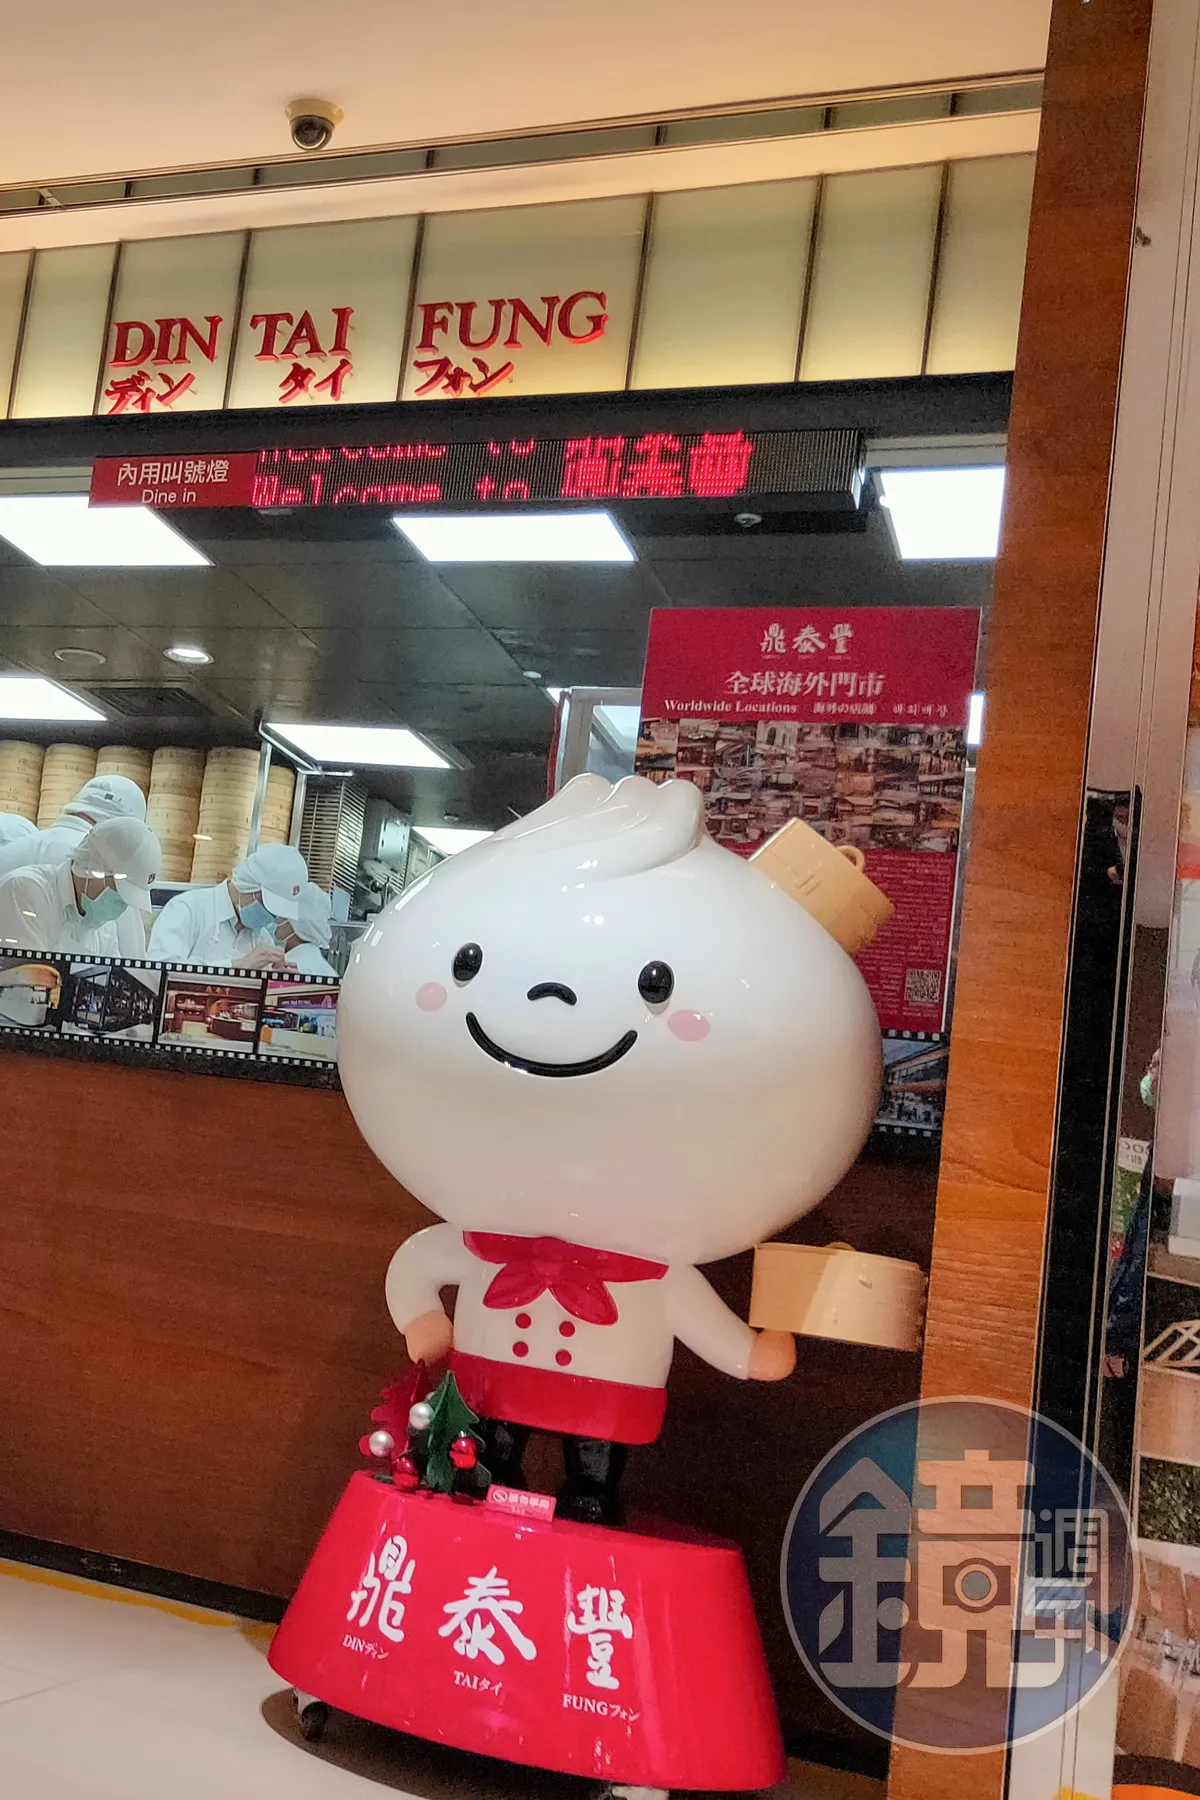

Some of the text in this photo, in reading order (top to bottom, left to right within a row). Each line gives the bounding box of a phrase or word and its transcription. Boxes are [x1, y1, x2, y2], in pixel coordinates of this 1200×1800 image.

[108, 290, 609, 368] DIN TAI FUNG
[103, 356, 516, 416] ディン タイ フォン
[142, 487, 197, 504] Dine in
[760, 622, 855, 654] 鼎泰豐
[724, 670, 887, 698] 全球海外門市
[664, 699, 798, 714] Worldwide Locations
[346, 1535, 633, 1690] 鼎泰豐
